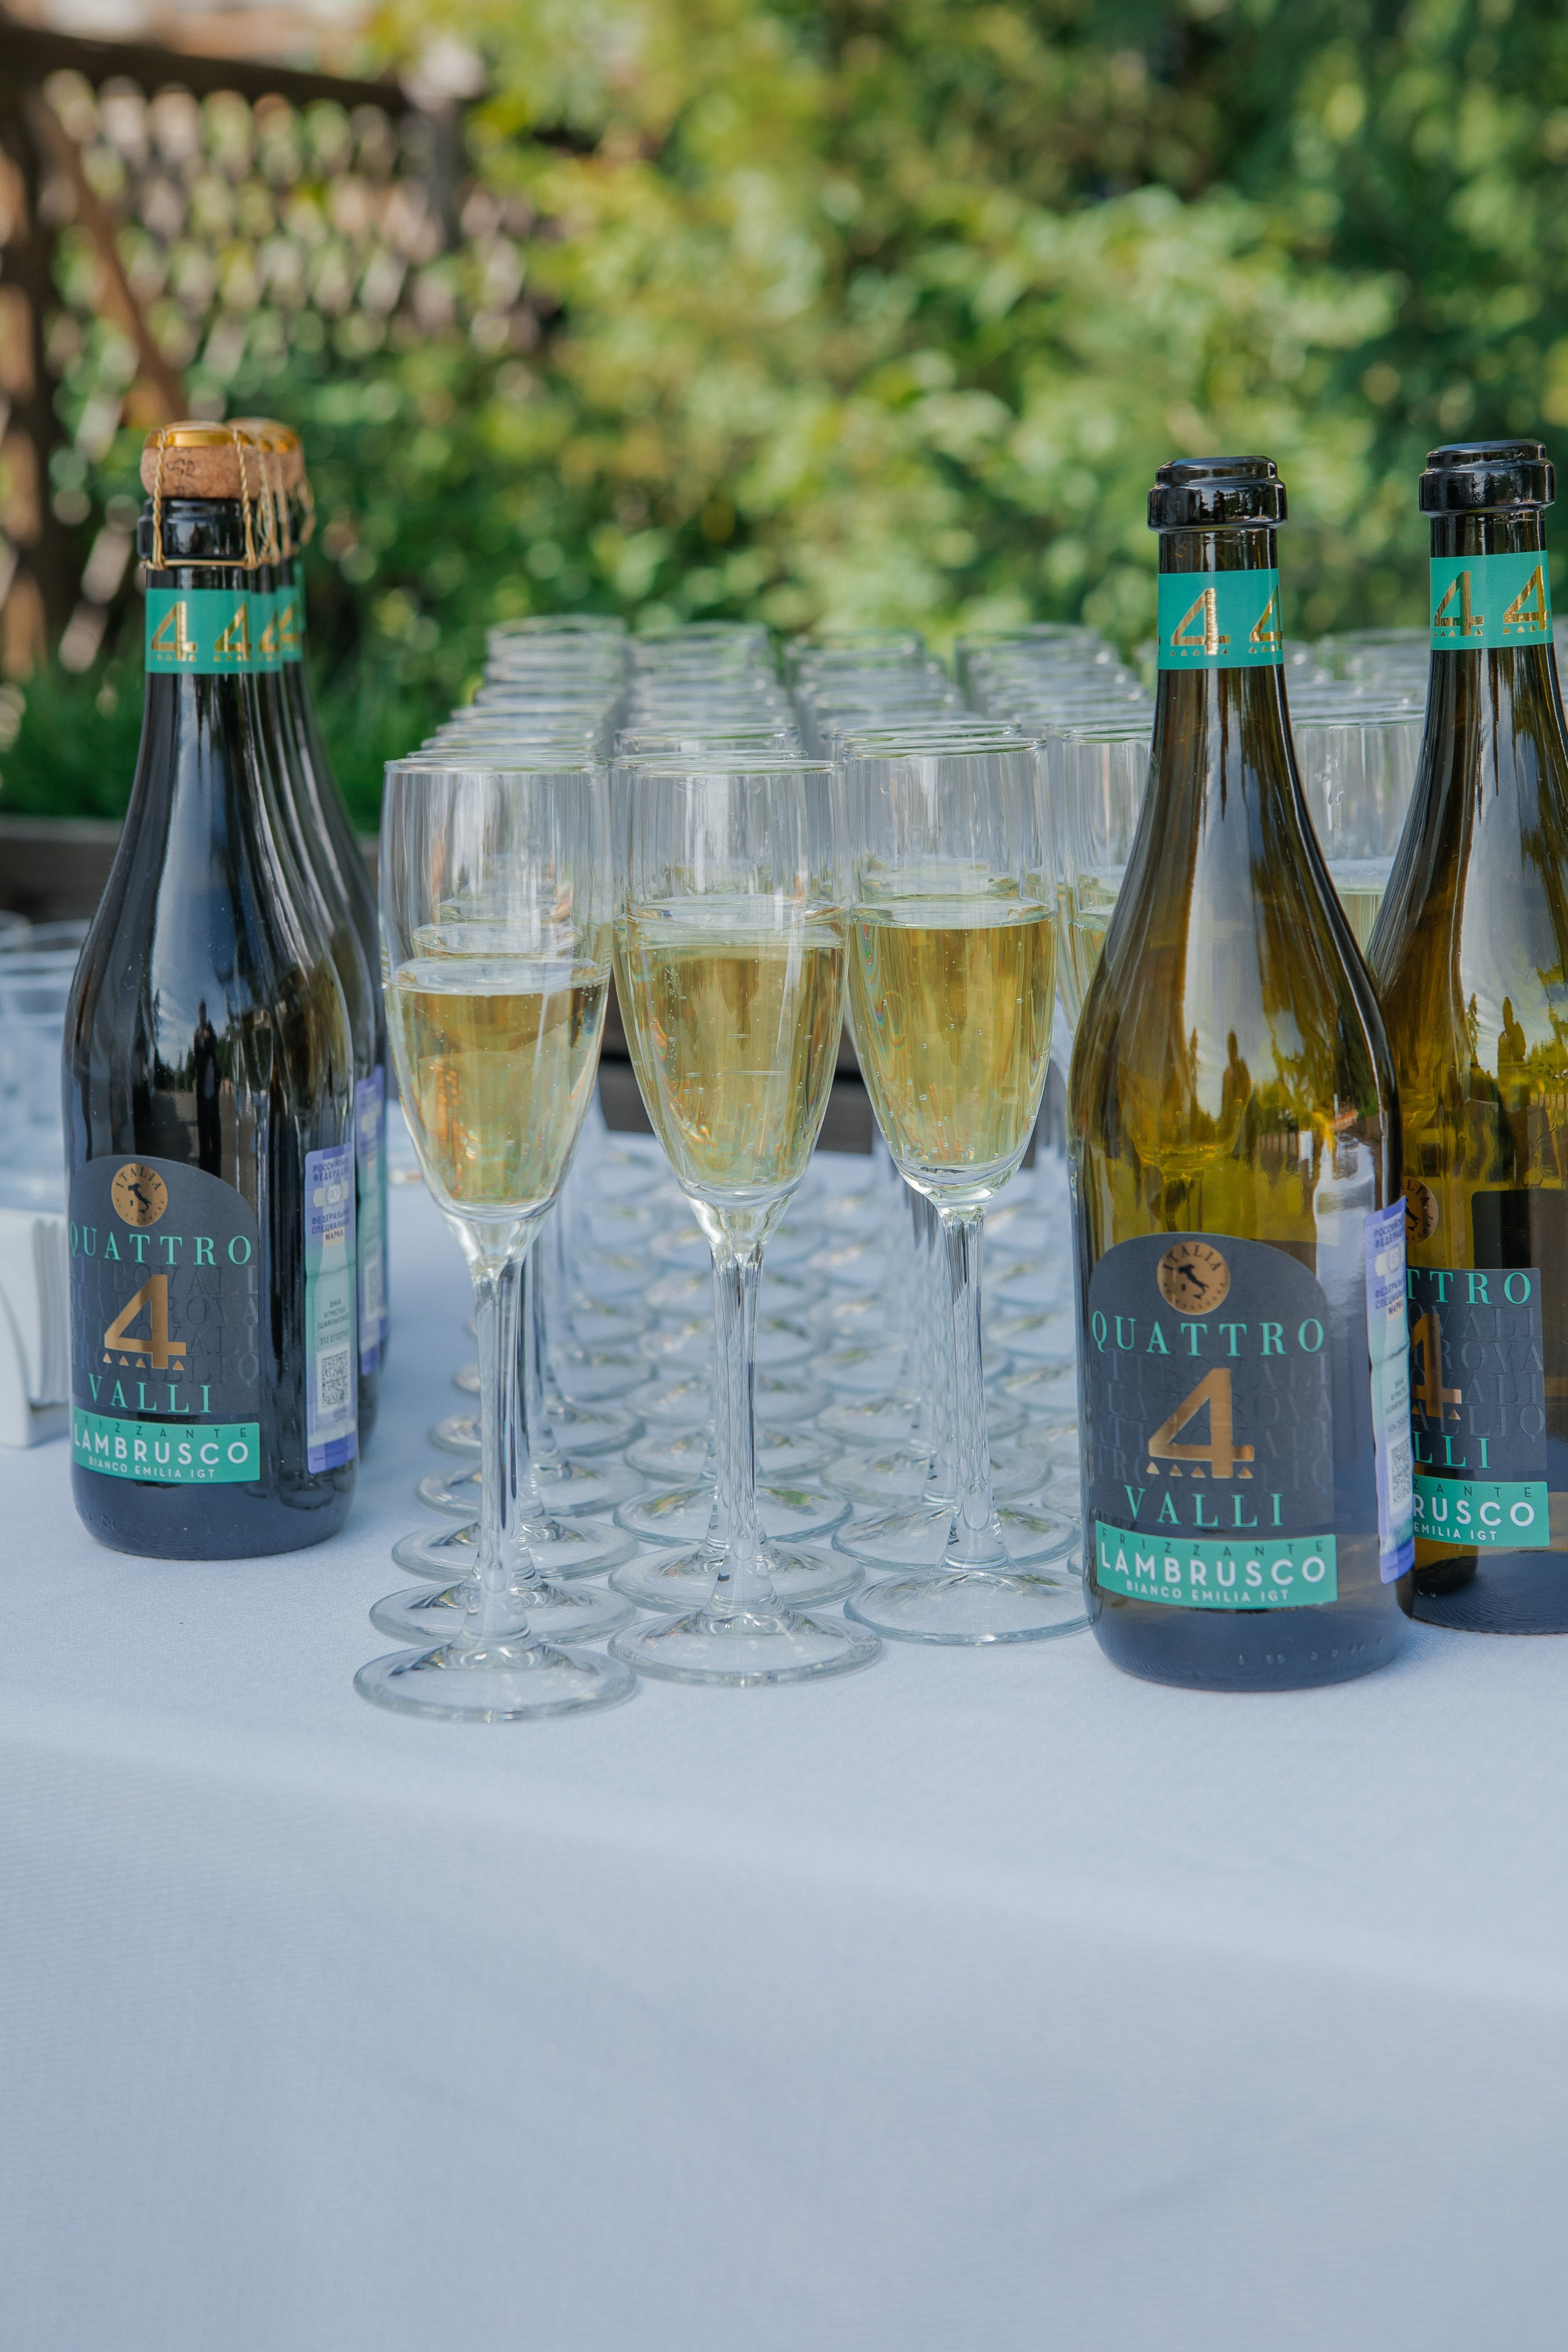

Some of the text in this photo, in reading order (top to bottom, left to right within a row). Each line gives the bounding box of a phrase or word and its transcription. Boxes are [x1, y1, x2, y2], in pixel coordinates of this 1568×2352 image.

[1250, 585, 1283, 650] 4
[1434, 571, 1484, 636] 4
[1504, 565, 1550, 630] 4
[151, 601, 197, 662] 4
[217, 602, 252, 662] 4
[1171, 587, 1231, 655] 4
[116, 1166, 162, 1191] ITALIA
[69, 1221, 252, 1266] QUATTRO
[1163, 1245, 1222, 1272] ITALIA
[104, 1273, 187, 1370] 4
[1091, 1310, 1325, 1357] QUATTRO
[88, 1373, 212, 1414] VALLI
[74, 1423, 249, 1466] LAMBRUSCO
[1148, 1367, 1254, 1479] 4
[88, 1455, 216, 1479] BIANCO EMILIA IGT
[1123, 1484, 1284, 1528] VALLI
[1102, 1527, 1324, 1557] FRIZZANTE
[1414, 1522, 1498, 1542] EMILIA IGT
[1101, 1542, 1326, 1588] LAMBRUSCO
[1126, 1579, 1289, 1603] BIANCO EMILIA IGT
